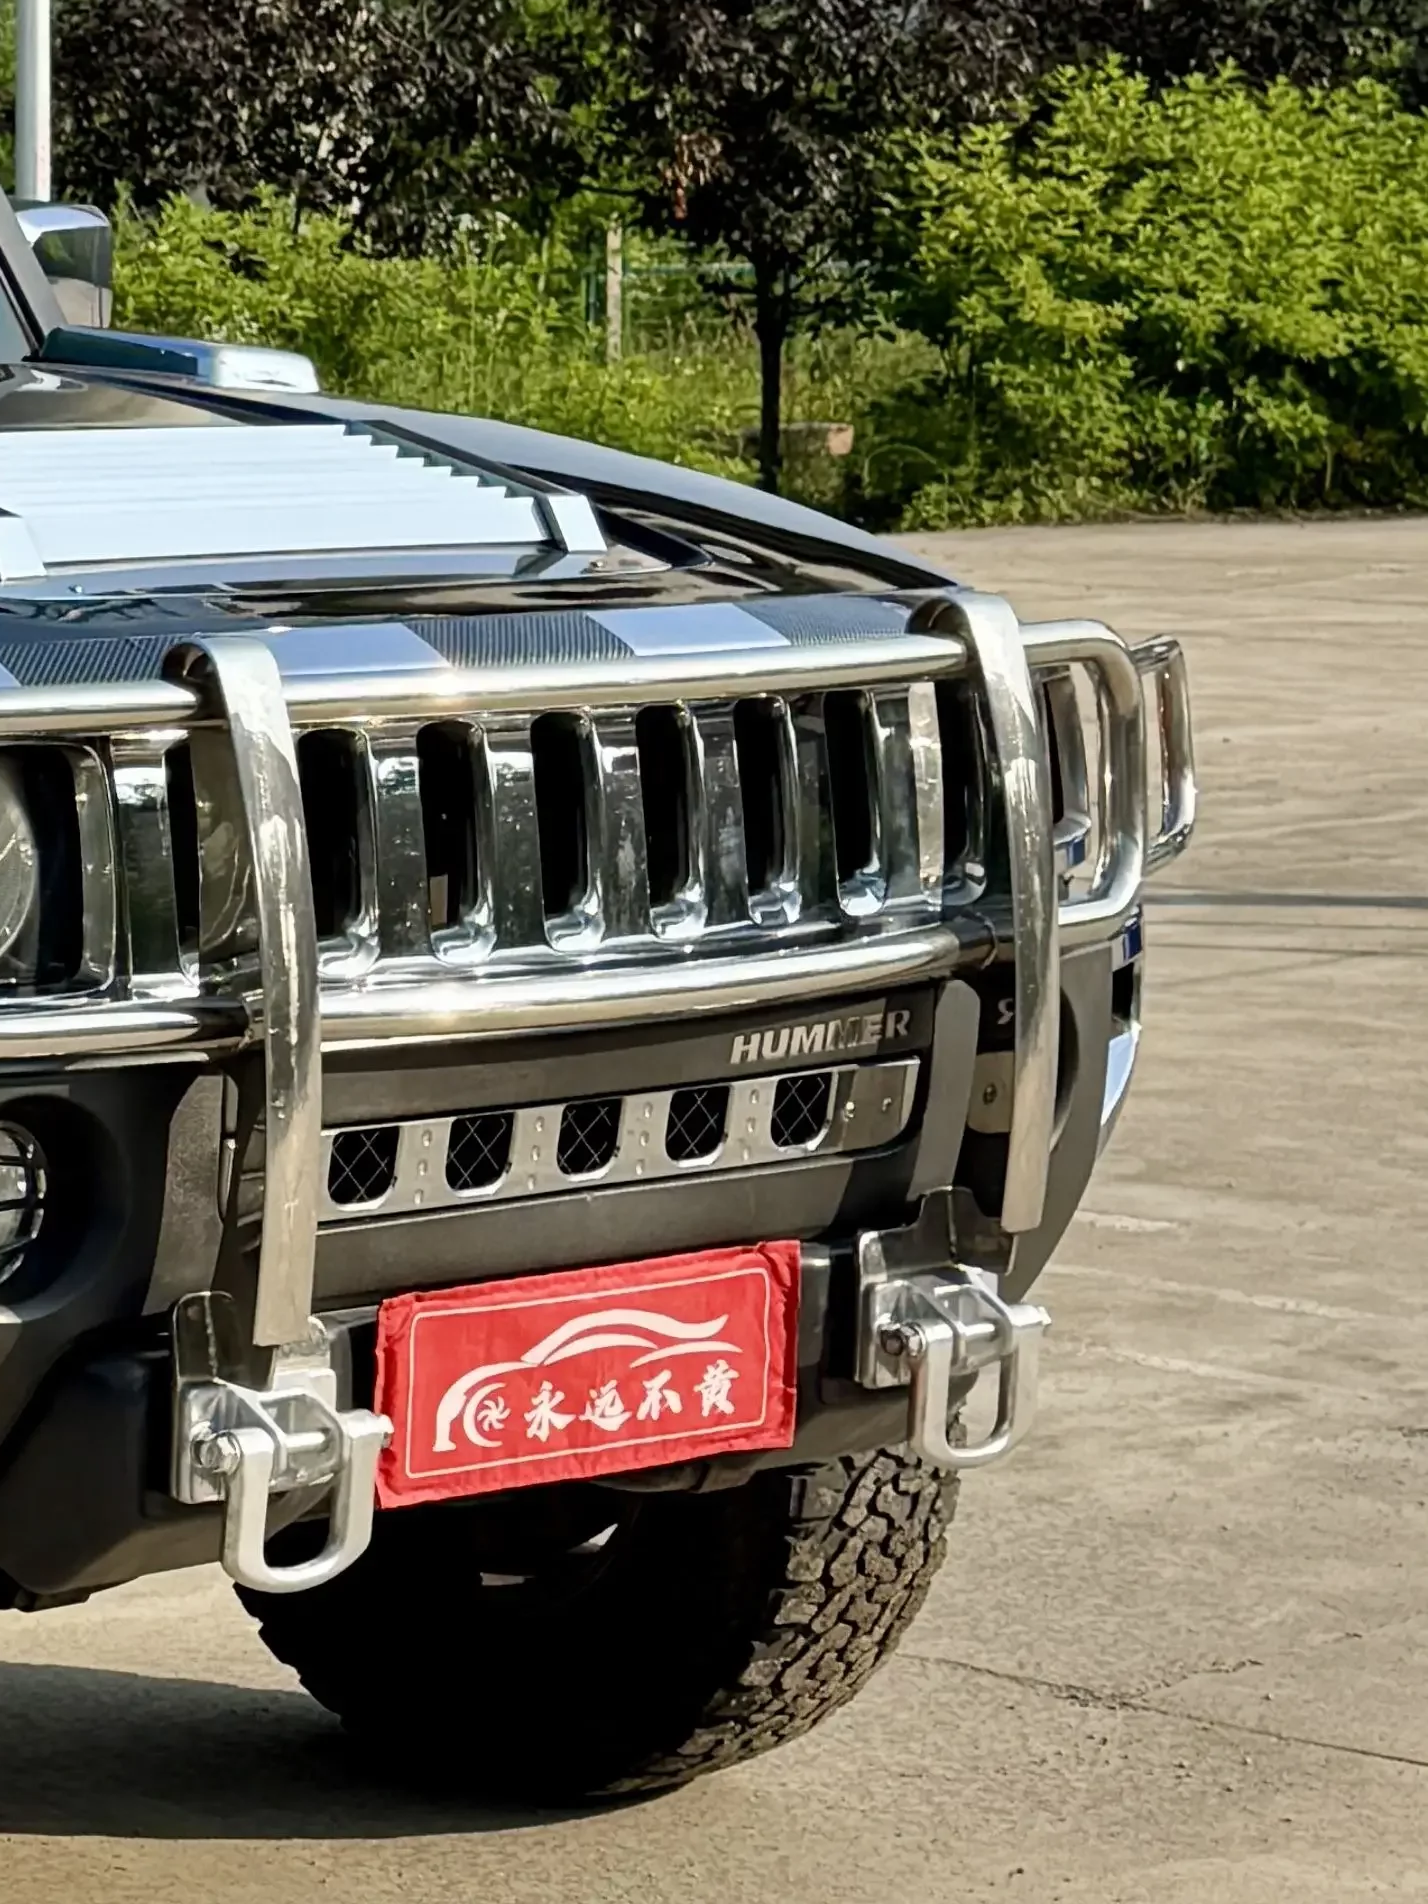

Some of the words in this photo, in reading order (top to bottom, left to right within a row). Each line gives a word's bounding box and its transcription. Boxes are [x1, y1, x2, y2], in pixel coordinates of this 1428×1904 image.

[730, 1008, 912, 1065] HUMMER
[523, 1359, 741, 1442] 永远不黄
